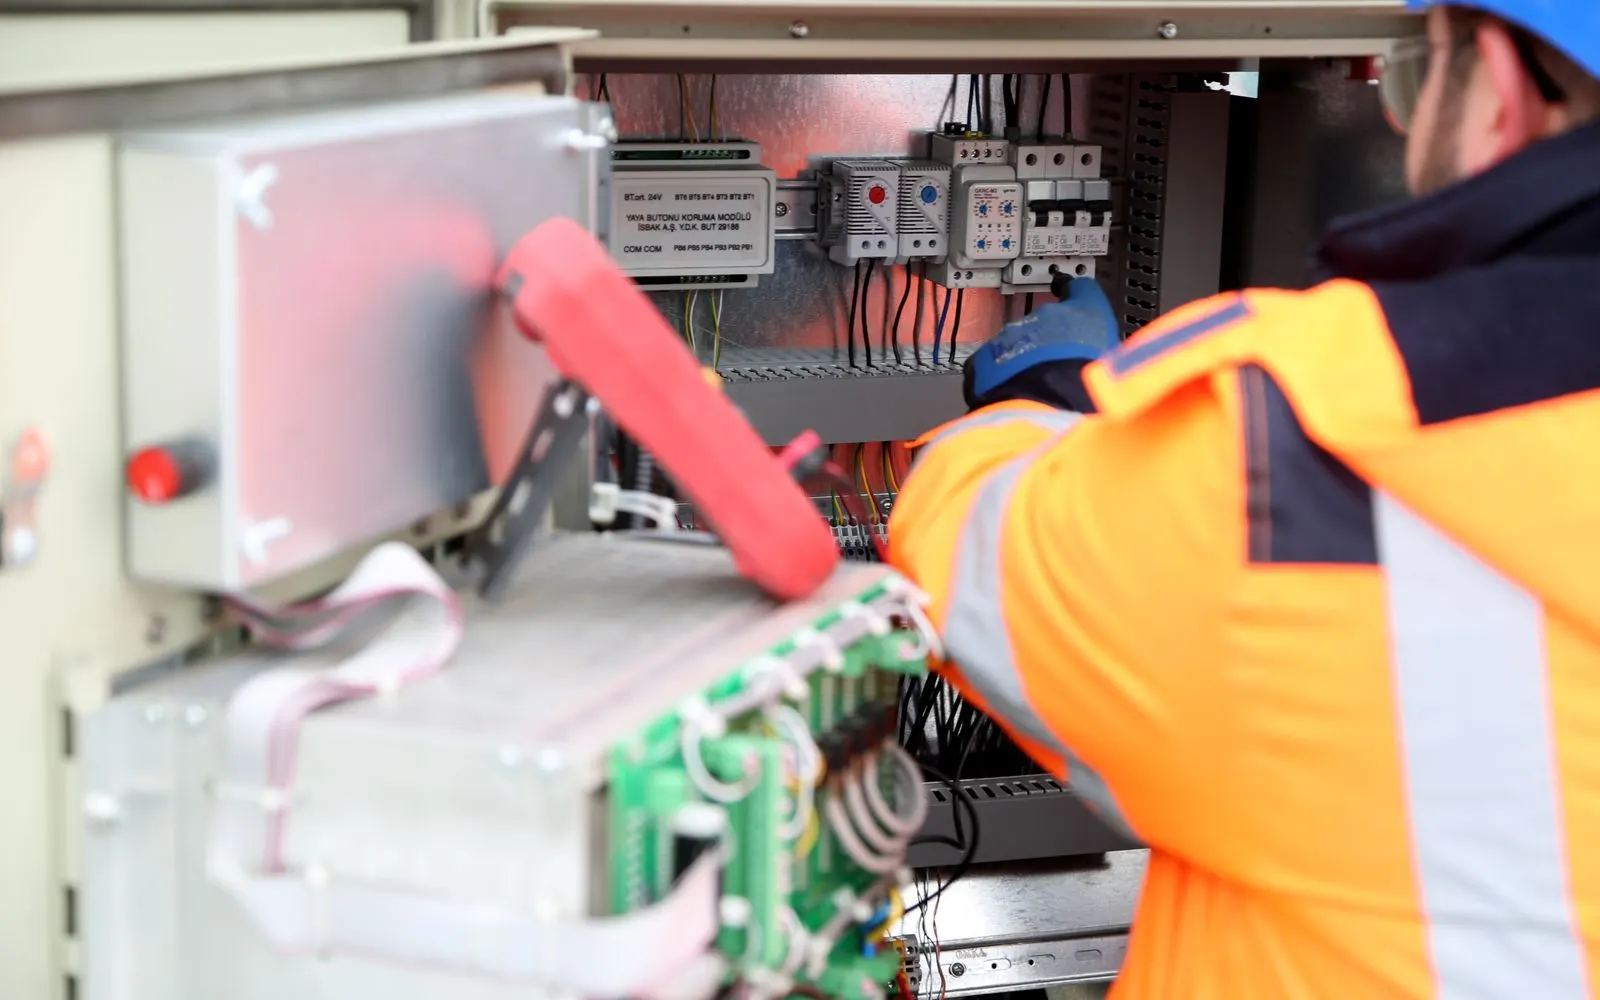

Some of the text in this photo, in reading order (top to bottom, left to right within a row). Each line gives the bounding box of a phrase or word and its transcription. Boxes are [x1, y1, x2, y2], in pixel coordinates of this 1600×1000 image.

[718, 212, 751, 221] MODÜLÜ
[638, 223, 661, 231] İSBAK
[662, 224, 677, 232] A.Ş.
